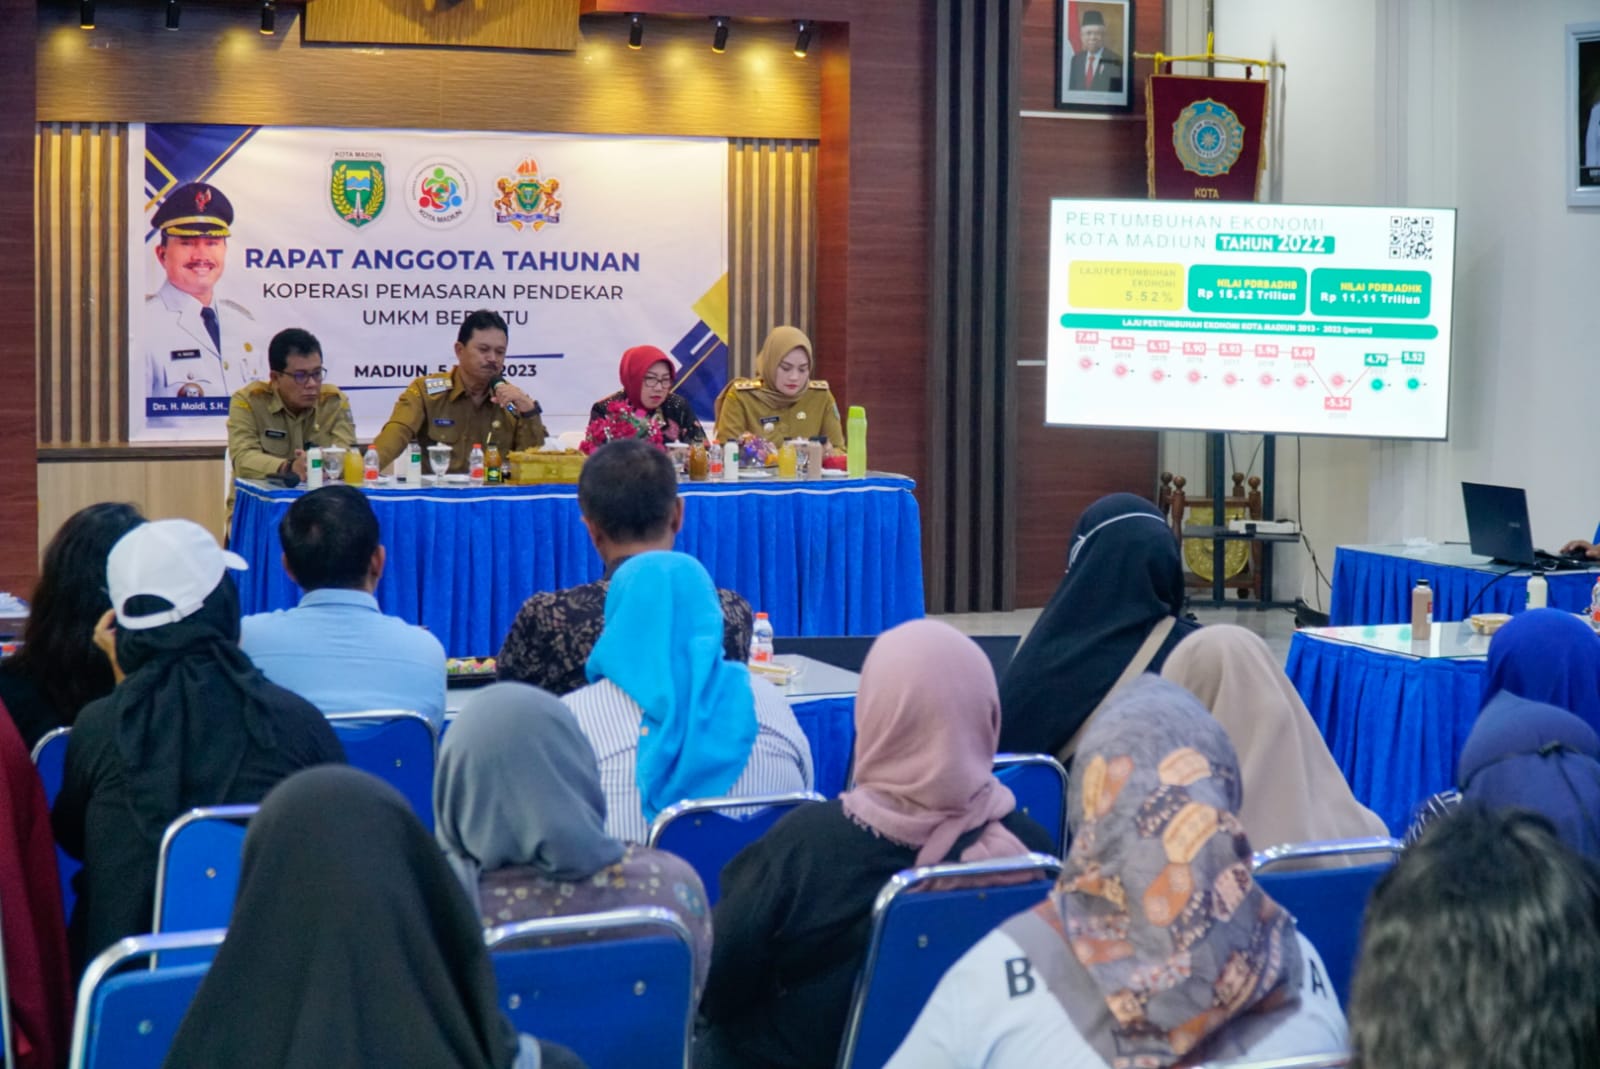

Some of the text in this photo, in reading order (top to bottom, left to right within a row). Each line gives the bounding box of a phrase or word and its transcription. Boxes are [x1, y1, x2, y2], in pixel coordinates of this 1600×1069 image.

[1194, 188, 1219, 198] KOTA
[1066, 211, 1324, 232] PERTUMBUHAN EKONOMI
[1065, 231, 1325, 252] KOTA MADIUN TAHUN 2022
[245, 248, 640, 272] RAPAT ANGGOTA TAHUNAN
[263, 283, 623, 300] KOPERASI PEMASARAN PENDEKAR
[1197, 288, 1214, 300] Rp
[1256, 290, 1296, 301] Triliun
[1320, 291, 1421, 305] Rp 11,11 Triliun
[363, 310, 428, 325] UMKM
[152, 402, 168, 410] Drs.
[170, 402, 179, 410] H.
